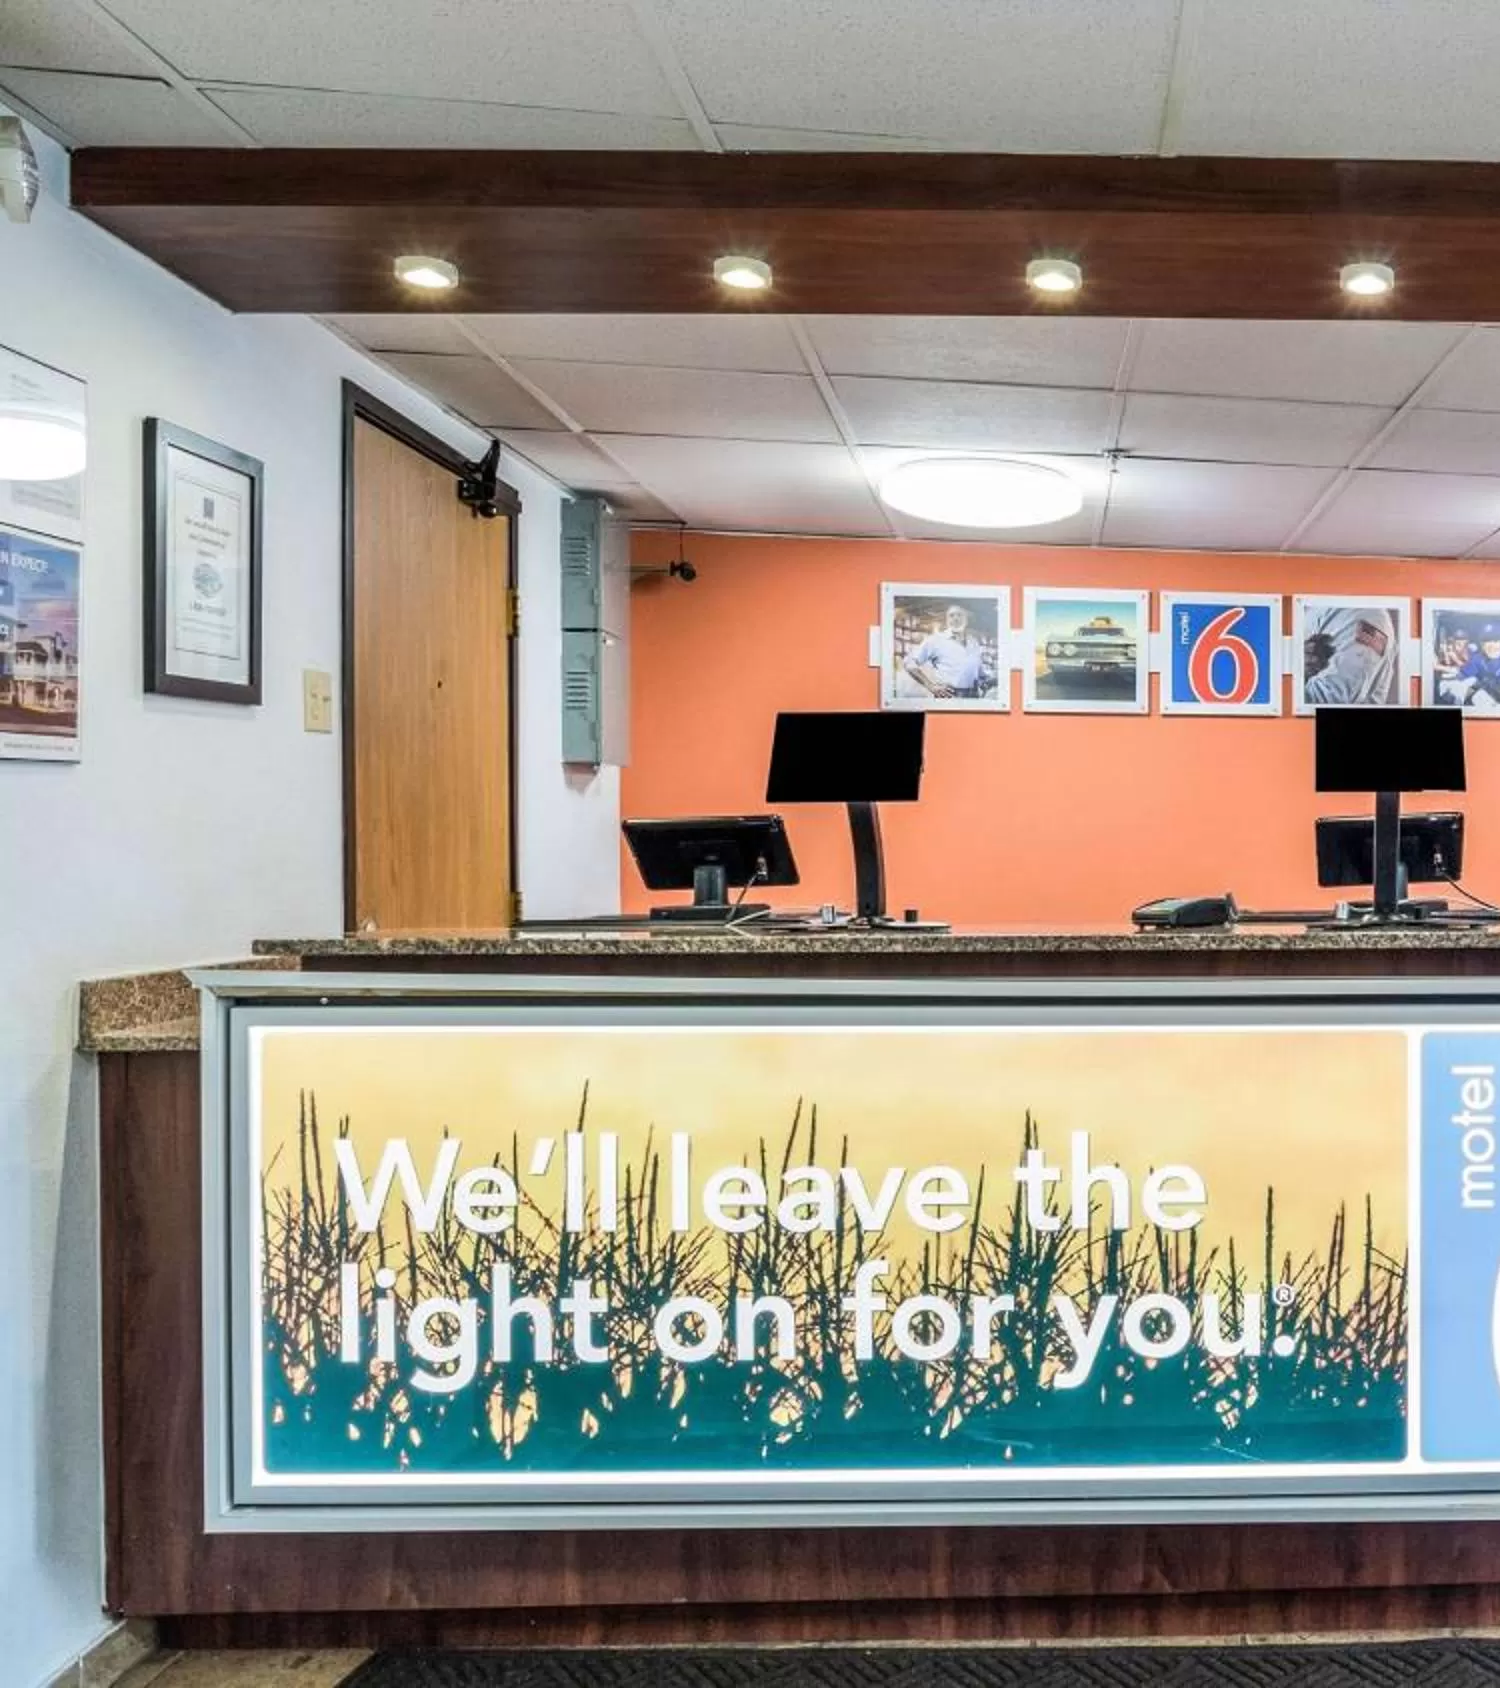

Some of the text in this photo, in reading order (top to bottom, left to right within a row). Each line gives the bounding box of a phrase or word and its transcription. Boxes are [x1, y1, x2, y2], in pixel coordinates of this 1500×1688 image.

[1178, 606, 1259, 704] motel 6
[334, 1131, 1208, 1233] We'll leave the
[1451, 1064, 1496, 1210] motel
[340, 1262, 609, 1393] light
[653, 1293, 798, 1363] on
[840, 1259, 1015, 1361] for
